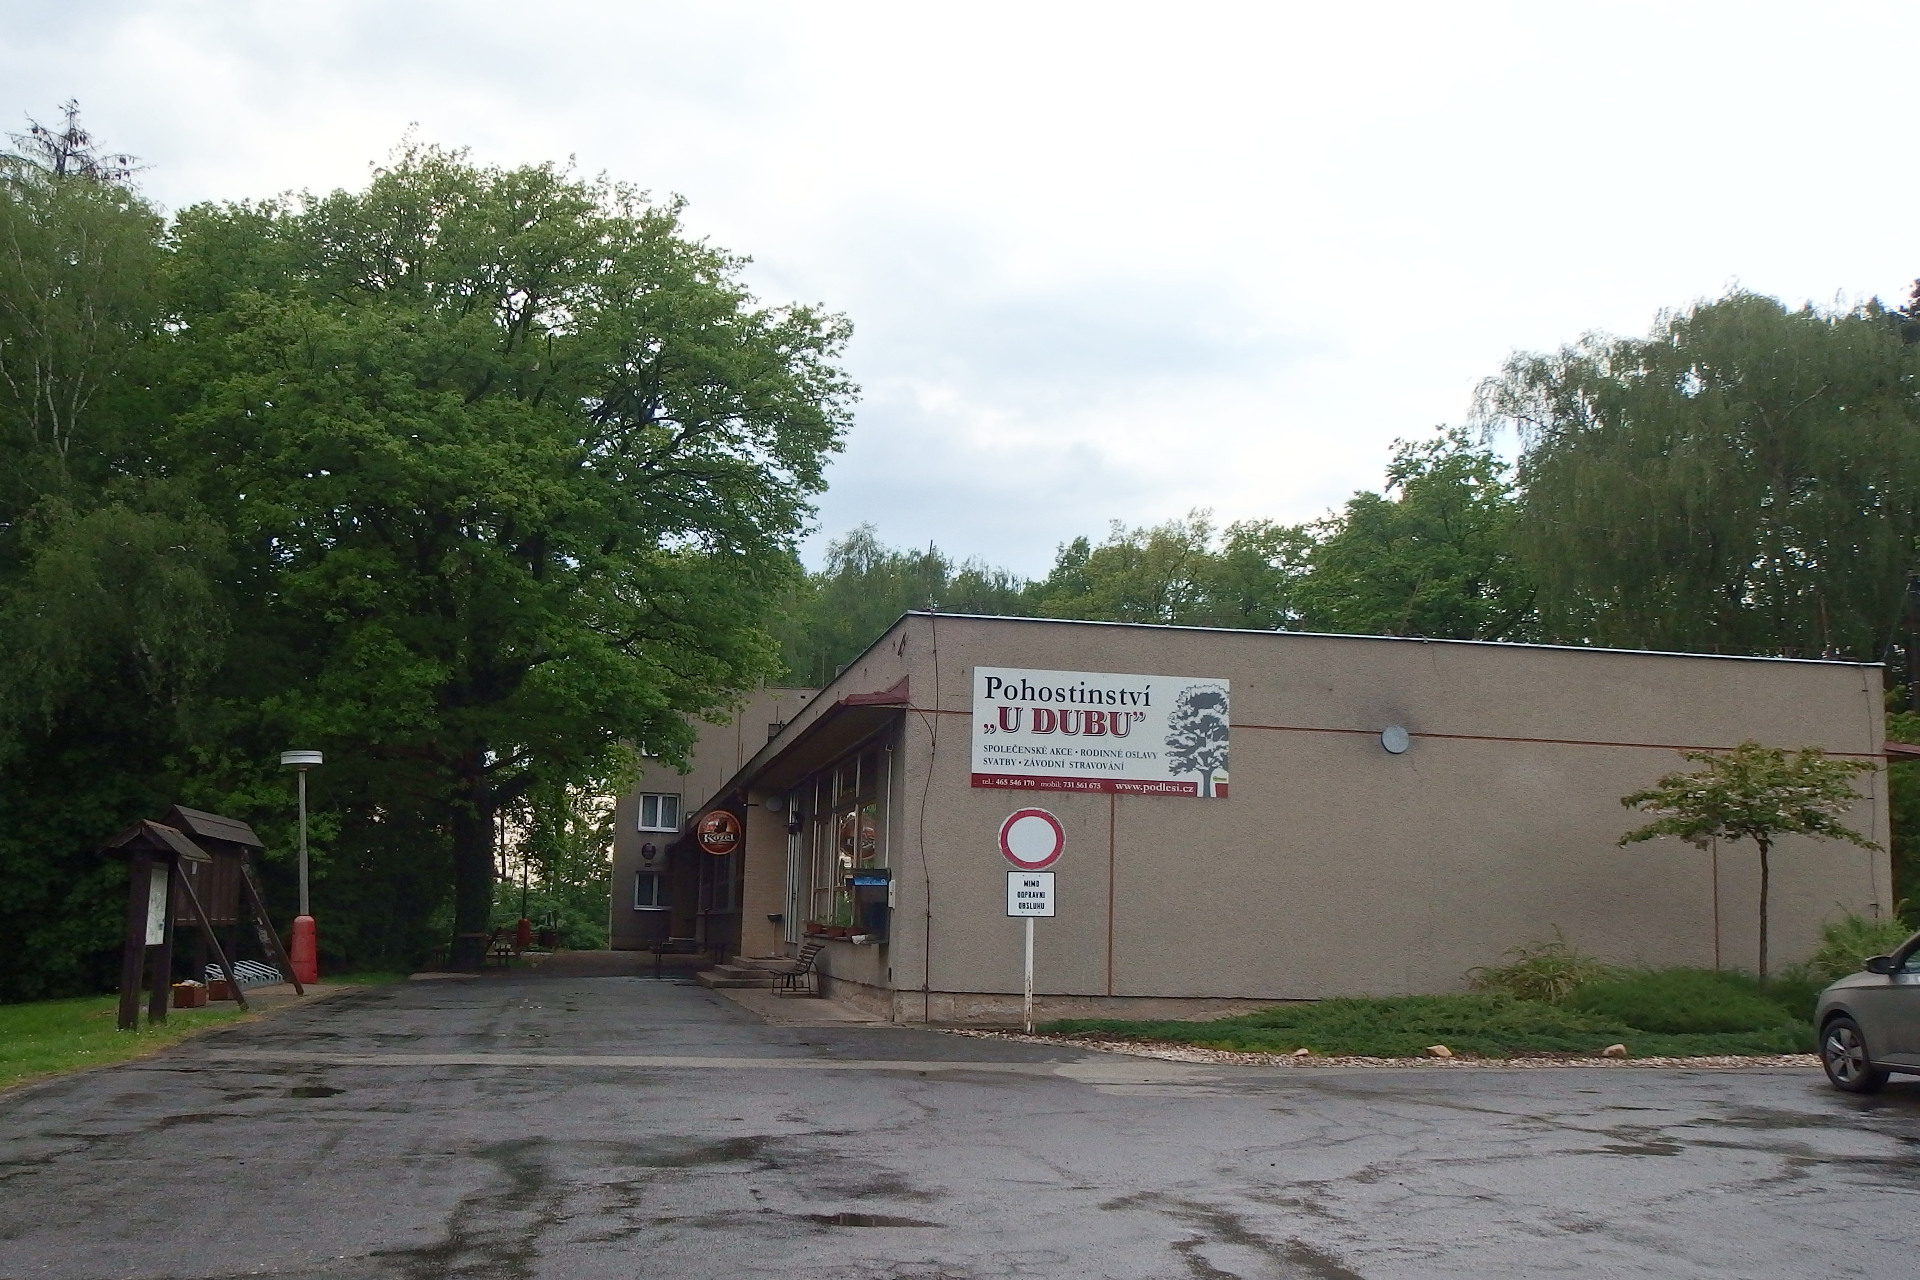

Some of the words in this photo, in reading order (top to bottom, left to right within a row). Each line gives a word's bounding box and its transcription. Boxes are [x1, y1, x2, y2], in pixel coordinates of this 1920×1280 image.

[984, 676, 1151, 707] Pohostinství
[983, 744, 1048, 755] SPOLEČENSKÉ
[1049, 747, 1073, 756] AKCE
[1080, 749, 1123, 758] RODINNÉ
[1125, 751, 1158, 760] OSLAVY
[983, 757, 1016, 766] SVATBY
[1023, 758, 1065, 769] ZÁVODNÍ
[1069, 761, 1124, 771] STRAVOVÁNÍ
[1009, 779, 1022, 787] 546
[1023, 780, 1035, 788] 170
[1063, 781, 1074, 789] 731
[1076, 782, 1087, 790] 561
[703, 833, 735, 843] Kozel
